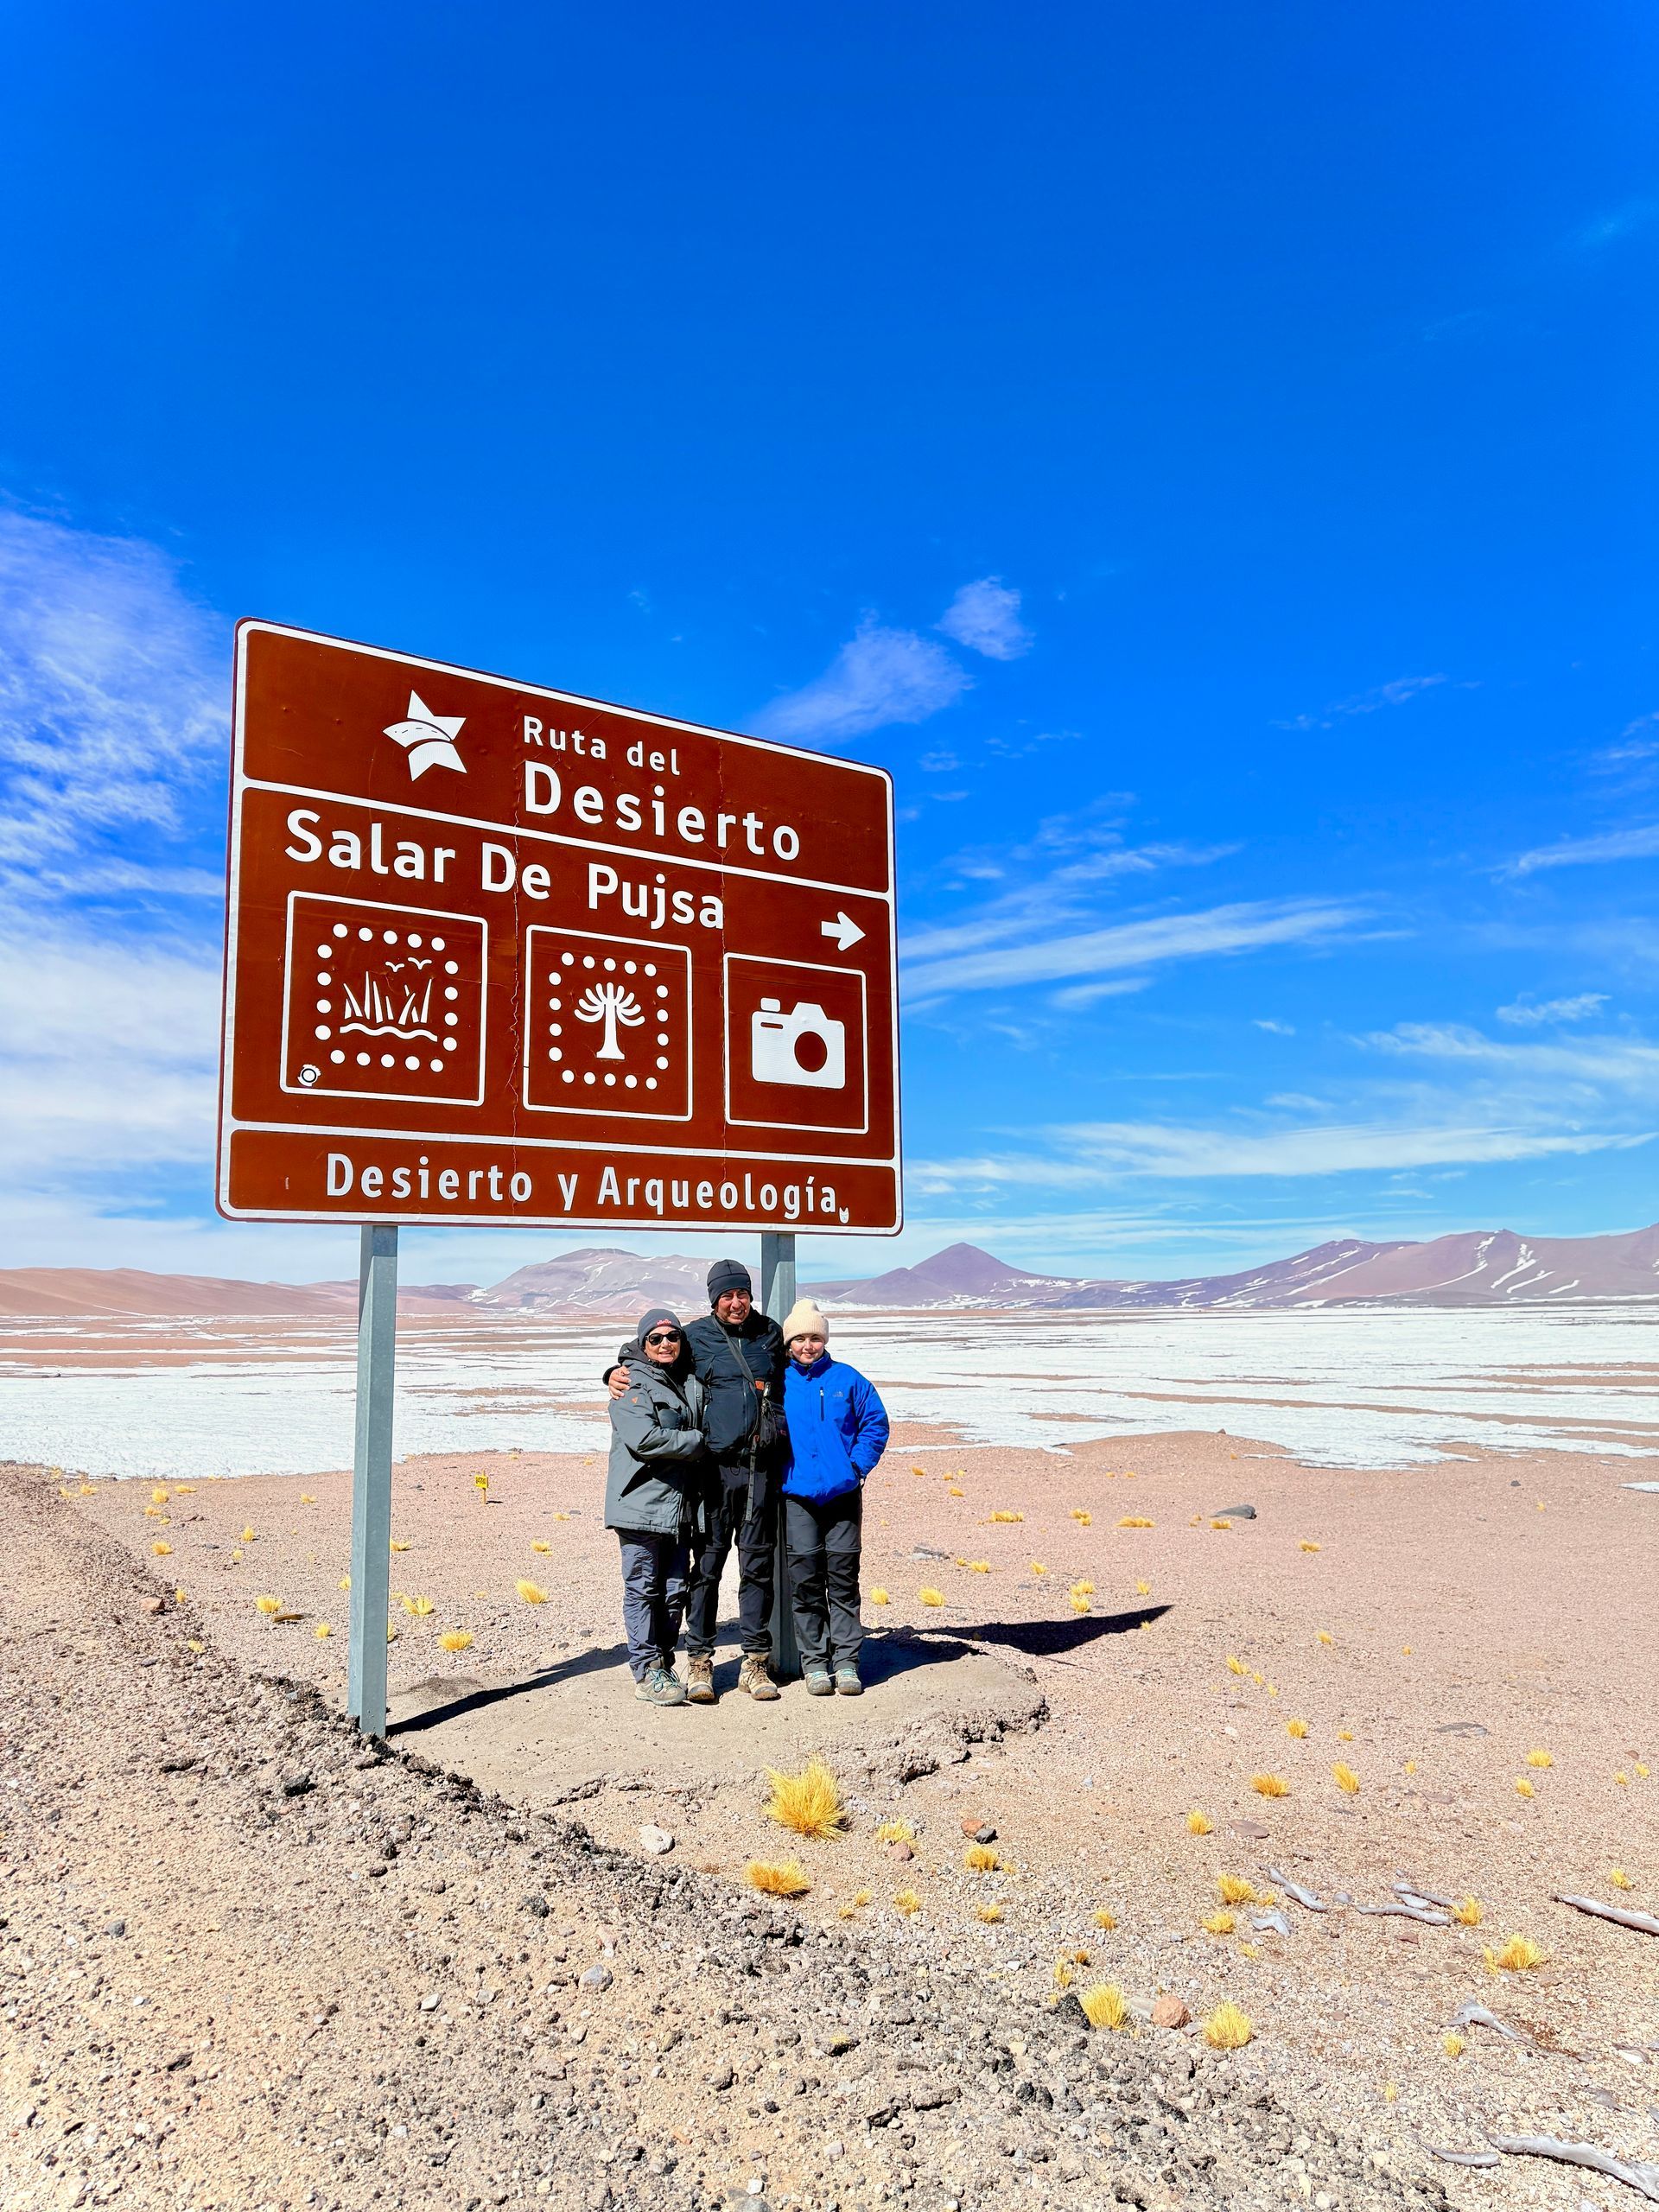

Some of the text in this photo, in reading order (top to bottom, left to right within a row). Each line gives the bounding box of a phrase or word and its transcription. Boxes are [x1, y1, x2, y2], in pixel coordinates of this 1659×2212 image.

[524, 715, 680, 776] Ruta del
[524, 760, 800, 861] Desierto
[284, 809, 724, 930] Salar De Pujsa
[327, 1153, 836, 1220] Desierto y Arqueología
